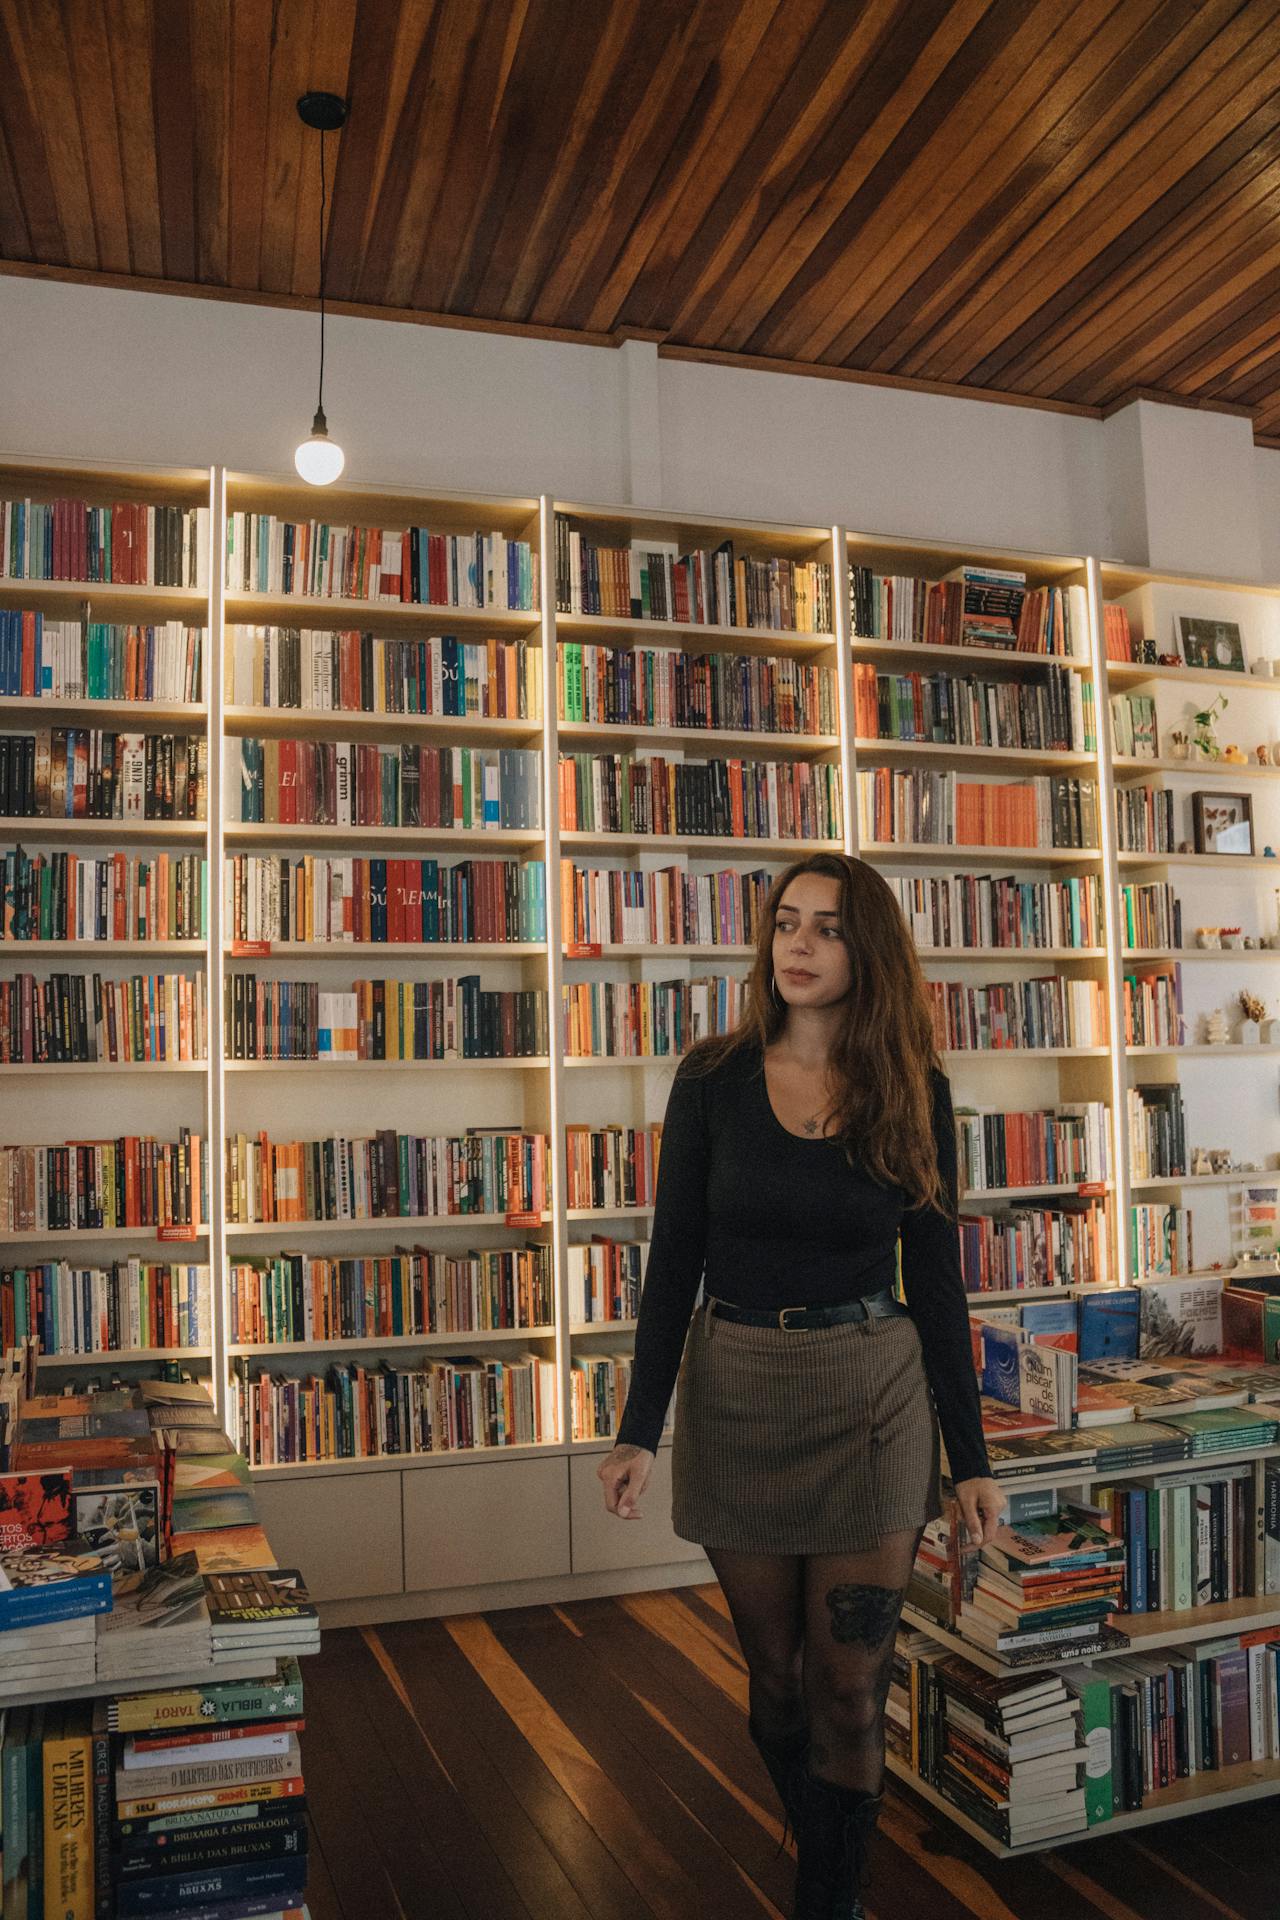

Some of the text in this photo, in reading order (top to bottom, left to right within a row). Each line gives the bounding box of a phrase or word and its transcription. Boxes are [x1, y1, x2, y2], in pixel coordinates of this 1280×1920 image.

[132, 761, 143, 783] KING
[337, 756, 350, 800] grimm
[1030, 1359, 1053, 1377] Num
[1026, 1372, 1053, 1389] piscar
[1029, 1396, 1055, 1415] olhos
[1041, 1388, 1054, 1402] de
[0, 1523, 23, 1534] TOS
[1061, 1644, 1103, 1658] uma noite
[1255, 1653, 1263, 1721] Rubens Ricupero
[153, 1704, 195, 1721] TAROT
[171, 1772, 178, 1785] O
[178, 1763, 218, 1785] MARTELO
[218, 1761, 234, 1781] DAS
[234, 1756, 284, 1779] FEITICEIRAS
[53, 1761, 68, 1831] E DEUSAS
[69, 1749, 86, 1829] MULHERES
[135, 1801, 157, 1814] SEU
[157, 1794, 216, 1811] HORÓSCOPO
[216, 1788, 249, 1803] CHINÊS
[97, 1740, 112, 1888] CIRCE MADELINE MILLER
[164, 1807, 242, 1826] BRUXA NATURAL
[173, 1816, 290, 1843] BRUXARIA E ASTROLOGIA
[160, 1856, 168, 1865] A
[170, 1850, 205, 1864] BÍBLIA
[206, 1846, 227, 1860] DAS
[229, 1840, 273, 1856] BRUXAS
[179, 1881, 223, 1897] BRUXAS
